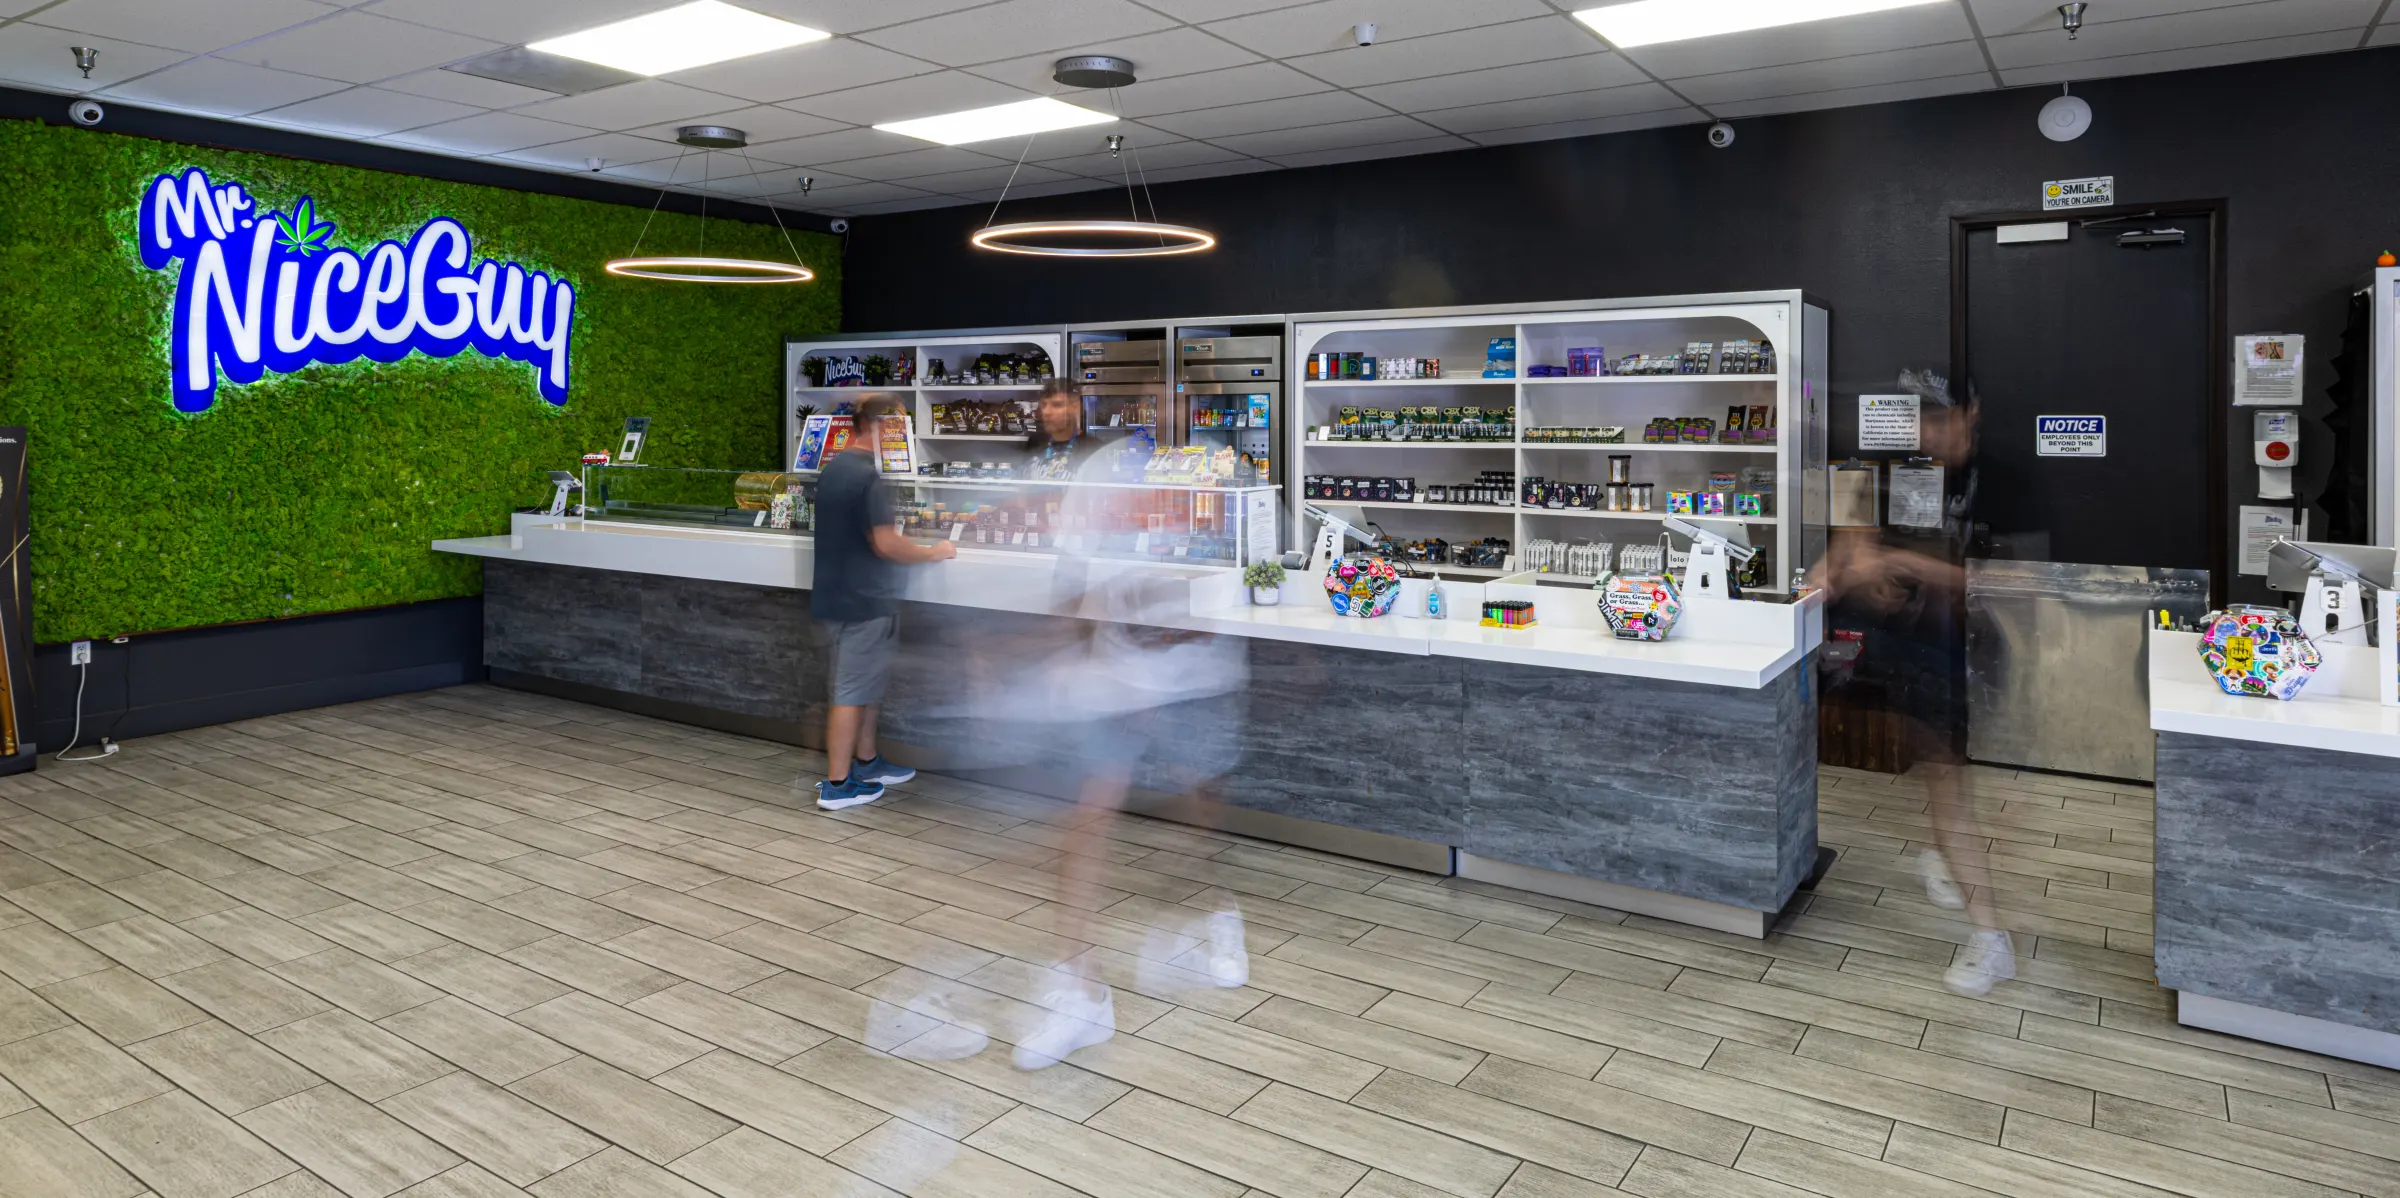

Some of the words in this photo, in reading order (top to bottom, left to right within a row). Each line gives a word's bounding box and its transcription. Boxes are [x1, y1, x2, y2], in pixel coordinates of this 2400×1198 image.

[2062, 183, 2094, 195] SMILE
[2047, 197, 2070, 207] YOU'RE
[2071, 197, 2081, 205] ON
[2082, 194, 2110, 204] CAMERA
[154, 170, 252, 250] Mr.
[188, 217, 573, 391] NiceGuy
[1342, 406, 1358, 415] CBX
[1363, 407, 1379, 416] CBX
[1380, 410, 1396, 420] CBX
[1401, 406, 1418, 416] CBX
[1421, 406, 1438, 416] CBX
[1443, 407, 1460, 416] CBX
[1462, 406, 1481, 416] CBX
[2044, 419, 2098, 432] NOTICE
[1215, 452, 1232, 461] RAW
[1325, 535, 1333, 548] 5
[1609, 592, 1632, 600] Grass,
[2327, 590, 2340, 609] 3
